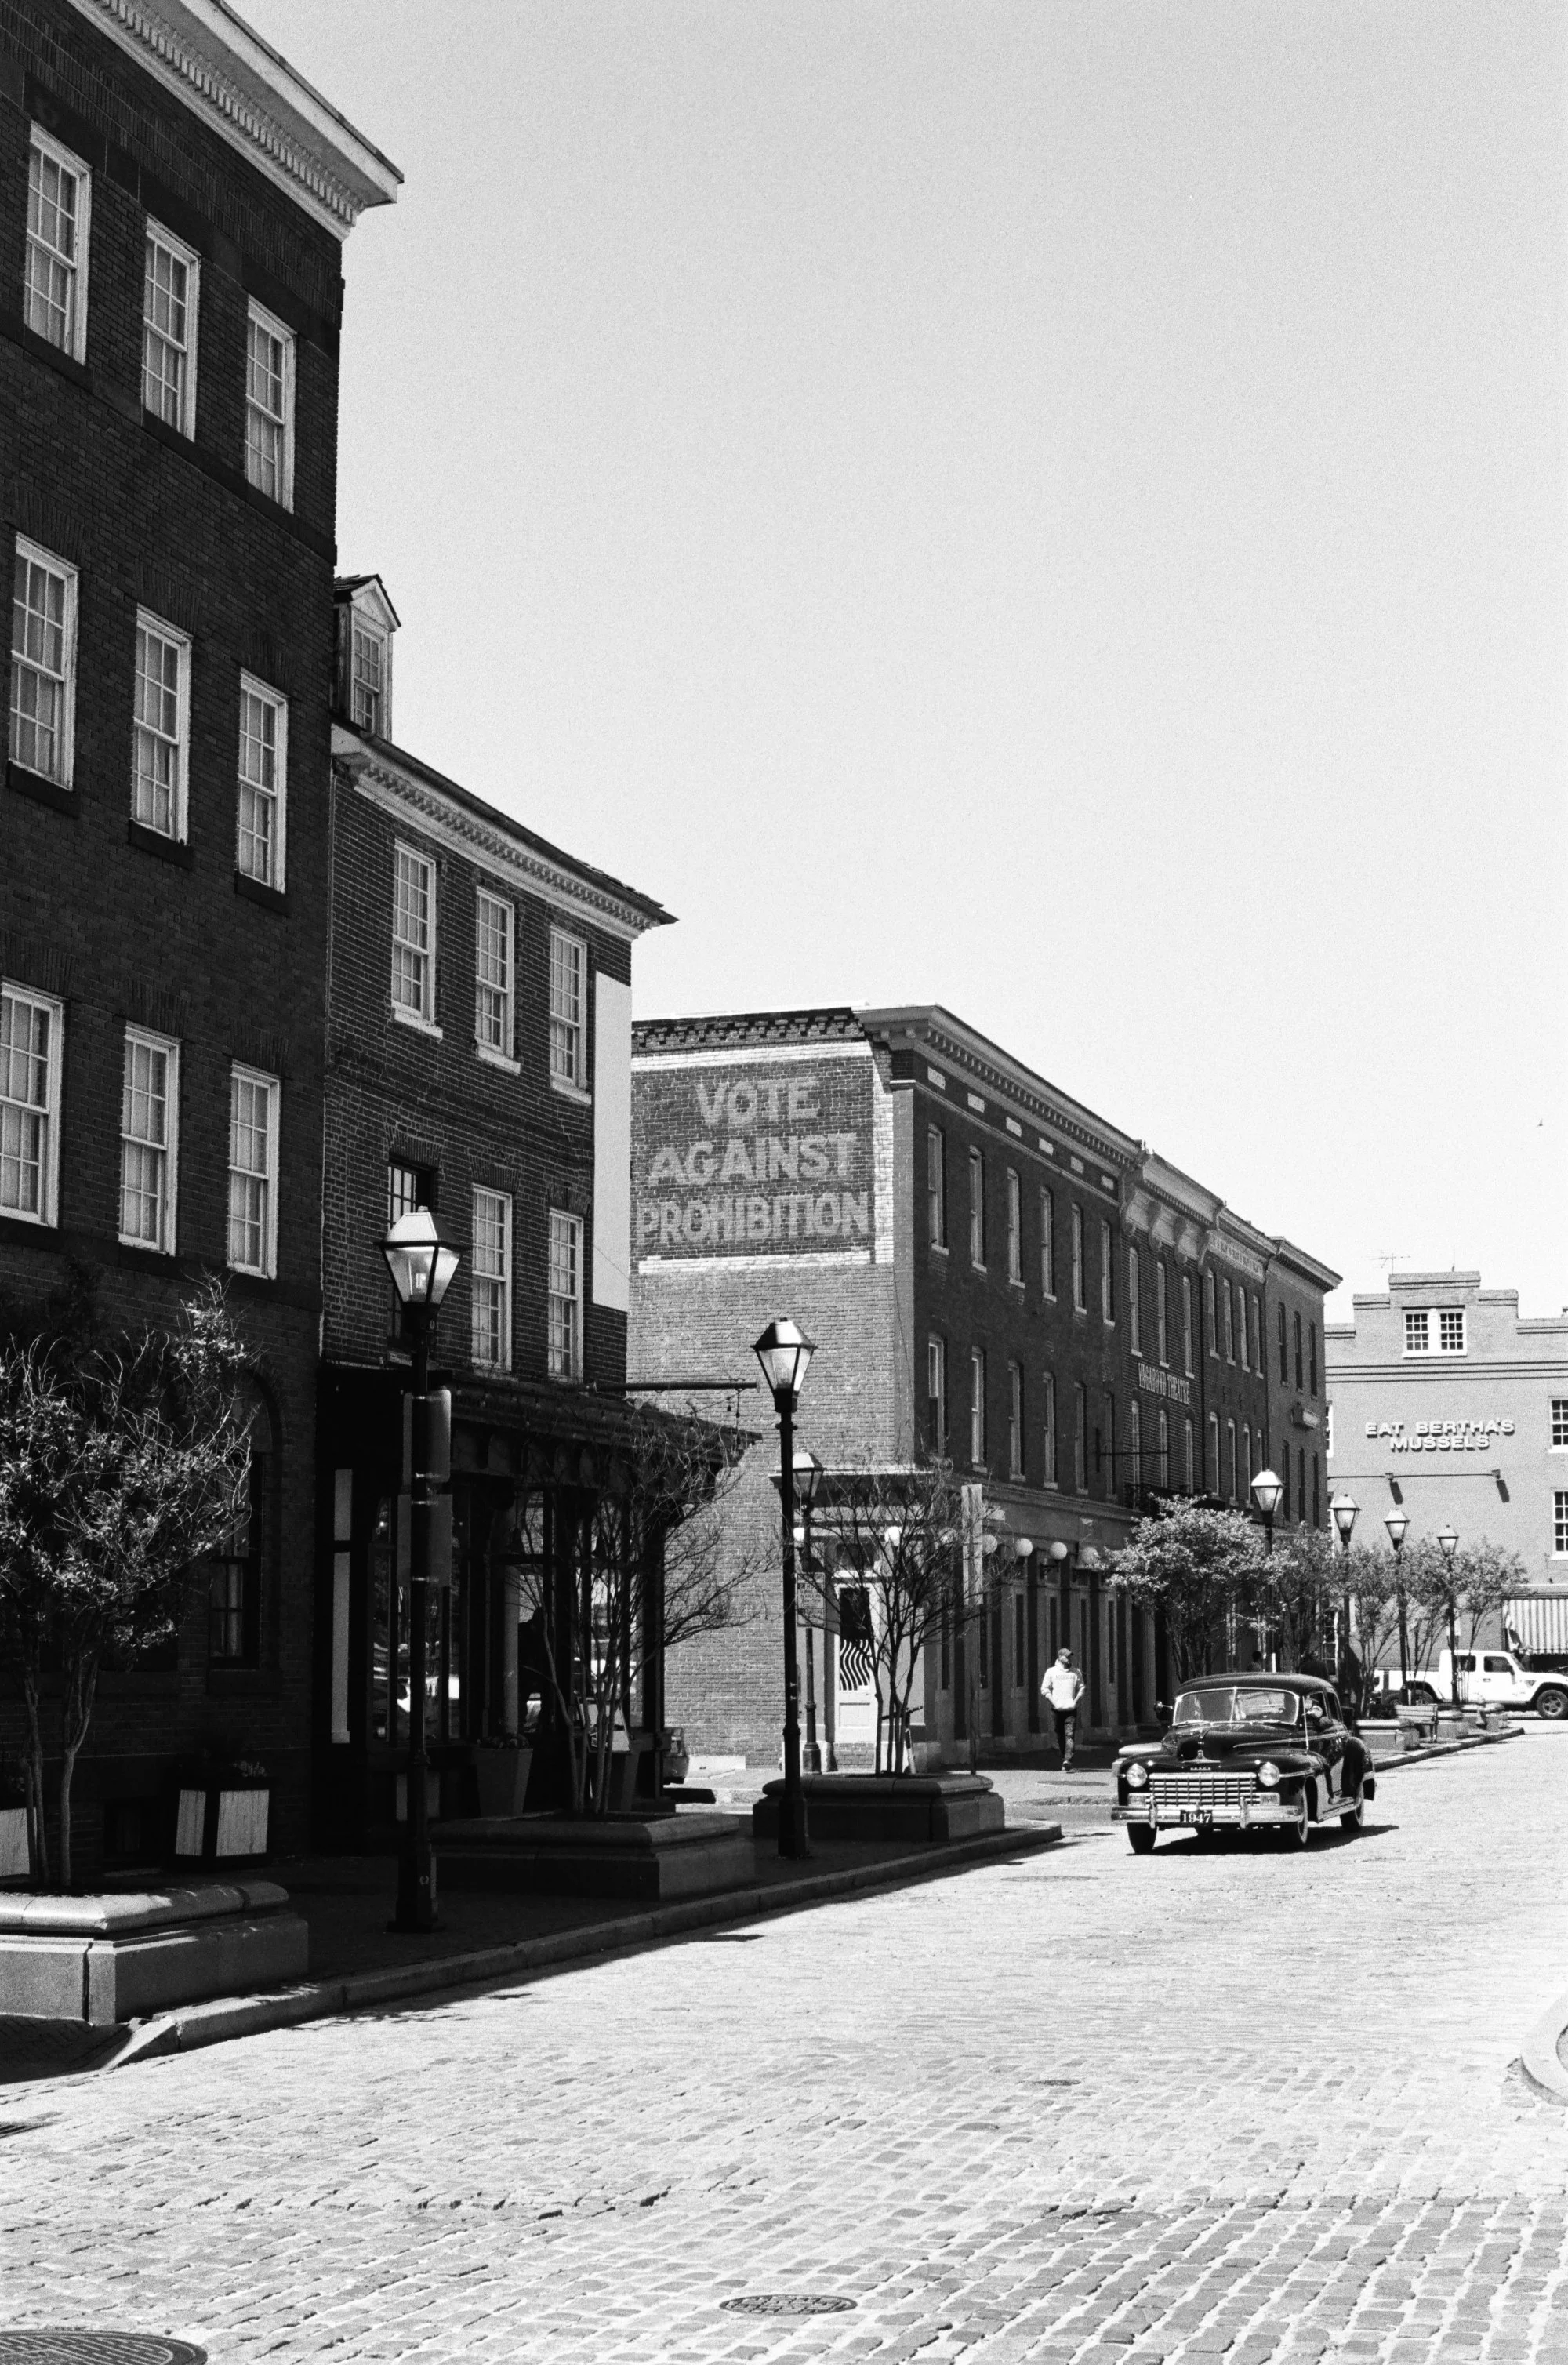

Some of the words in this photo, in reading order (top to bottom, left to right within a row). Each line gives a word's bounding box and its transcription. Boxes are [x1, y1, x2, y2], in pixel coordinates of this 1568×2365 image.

[695, 1077, 820, 1126] VOTE
[648, 1132, 857, 1185] AGAINST
[635, 1191, 869, 1244] PROHIBITION
[1365, 1422, 1404, 1437] EAT
[1415, 1418, 1515, 1435] BERTHA'S
[1390, 1436, 1490, 1451] MUSSELS
[1181, 1813, 1212, 1824] 1947
